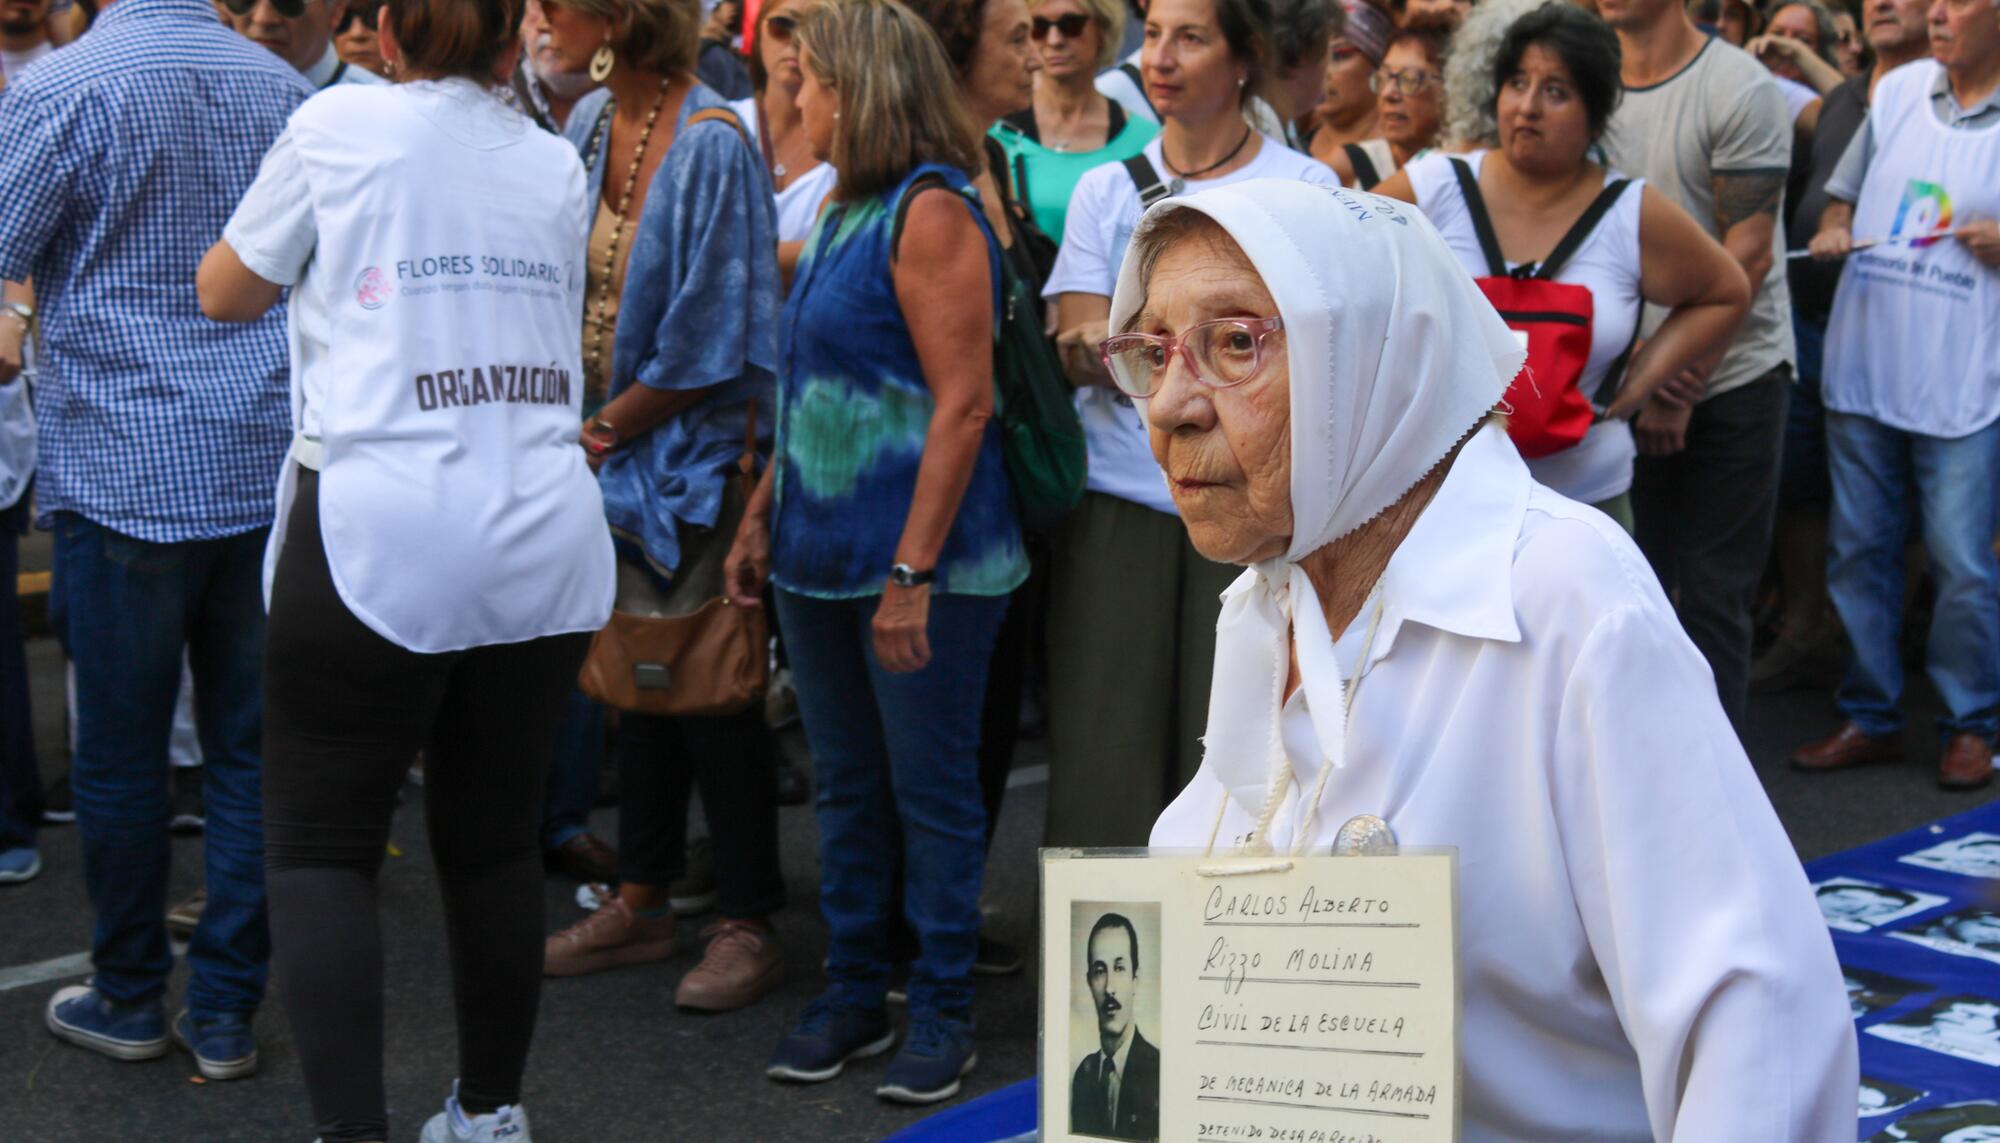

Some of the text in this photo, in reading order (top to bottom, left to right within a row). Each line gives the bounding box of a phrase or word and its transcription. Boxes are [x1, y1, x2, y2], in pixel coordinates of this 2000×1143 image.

[396, 255, 474, 280] FLORES
[415, 361, 571, 412] ORGANZACIÓN
[1204, 885, 1390, 922] CARLOS ALBERTO
[1286, 947, 1373, 972] MOLINA
[1197, 1003, 1405, 1038] CIVIL DE LA ESCUELA
[1199, 1075, 1437, 1105] DE MECANICA DE LA ARMADA
[1198, 1122, 1263, 1138] DETENIDO
